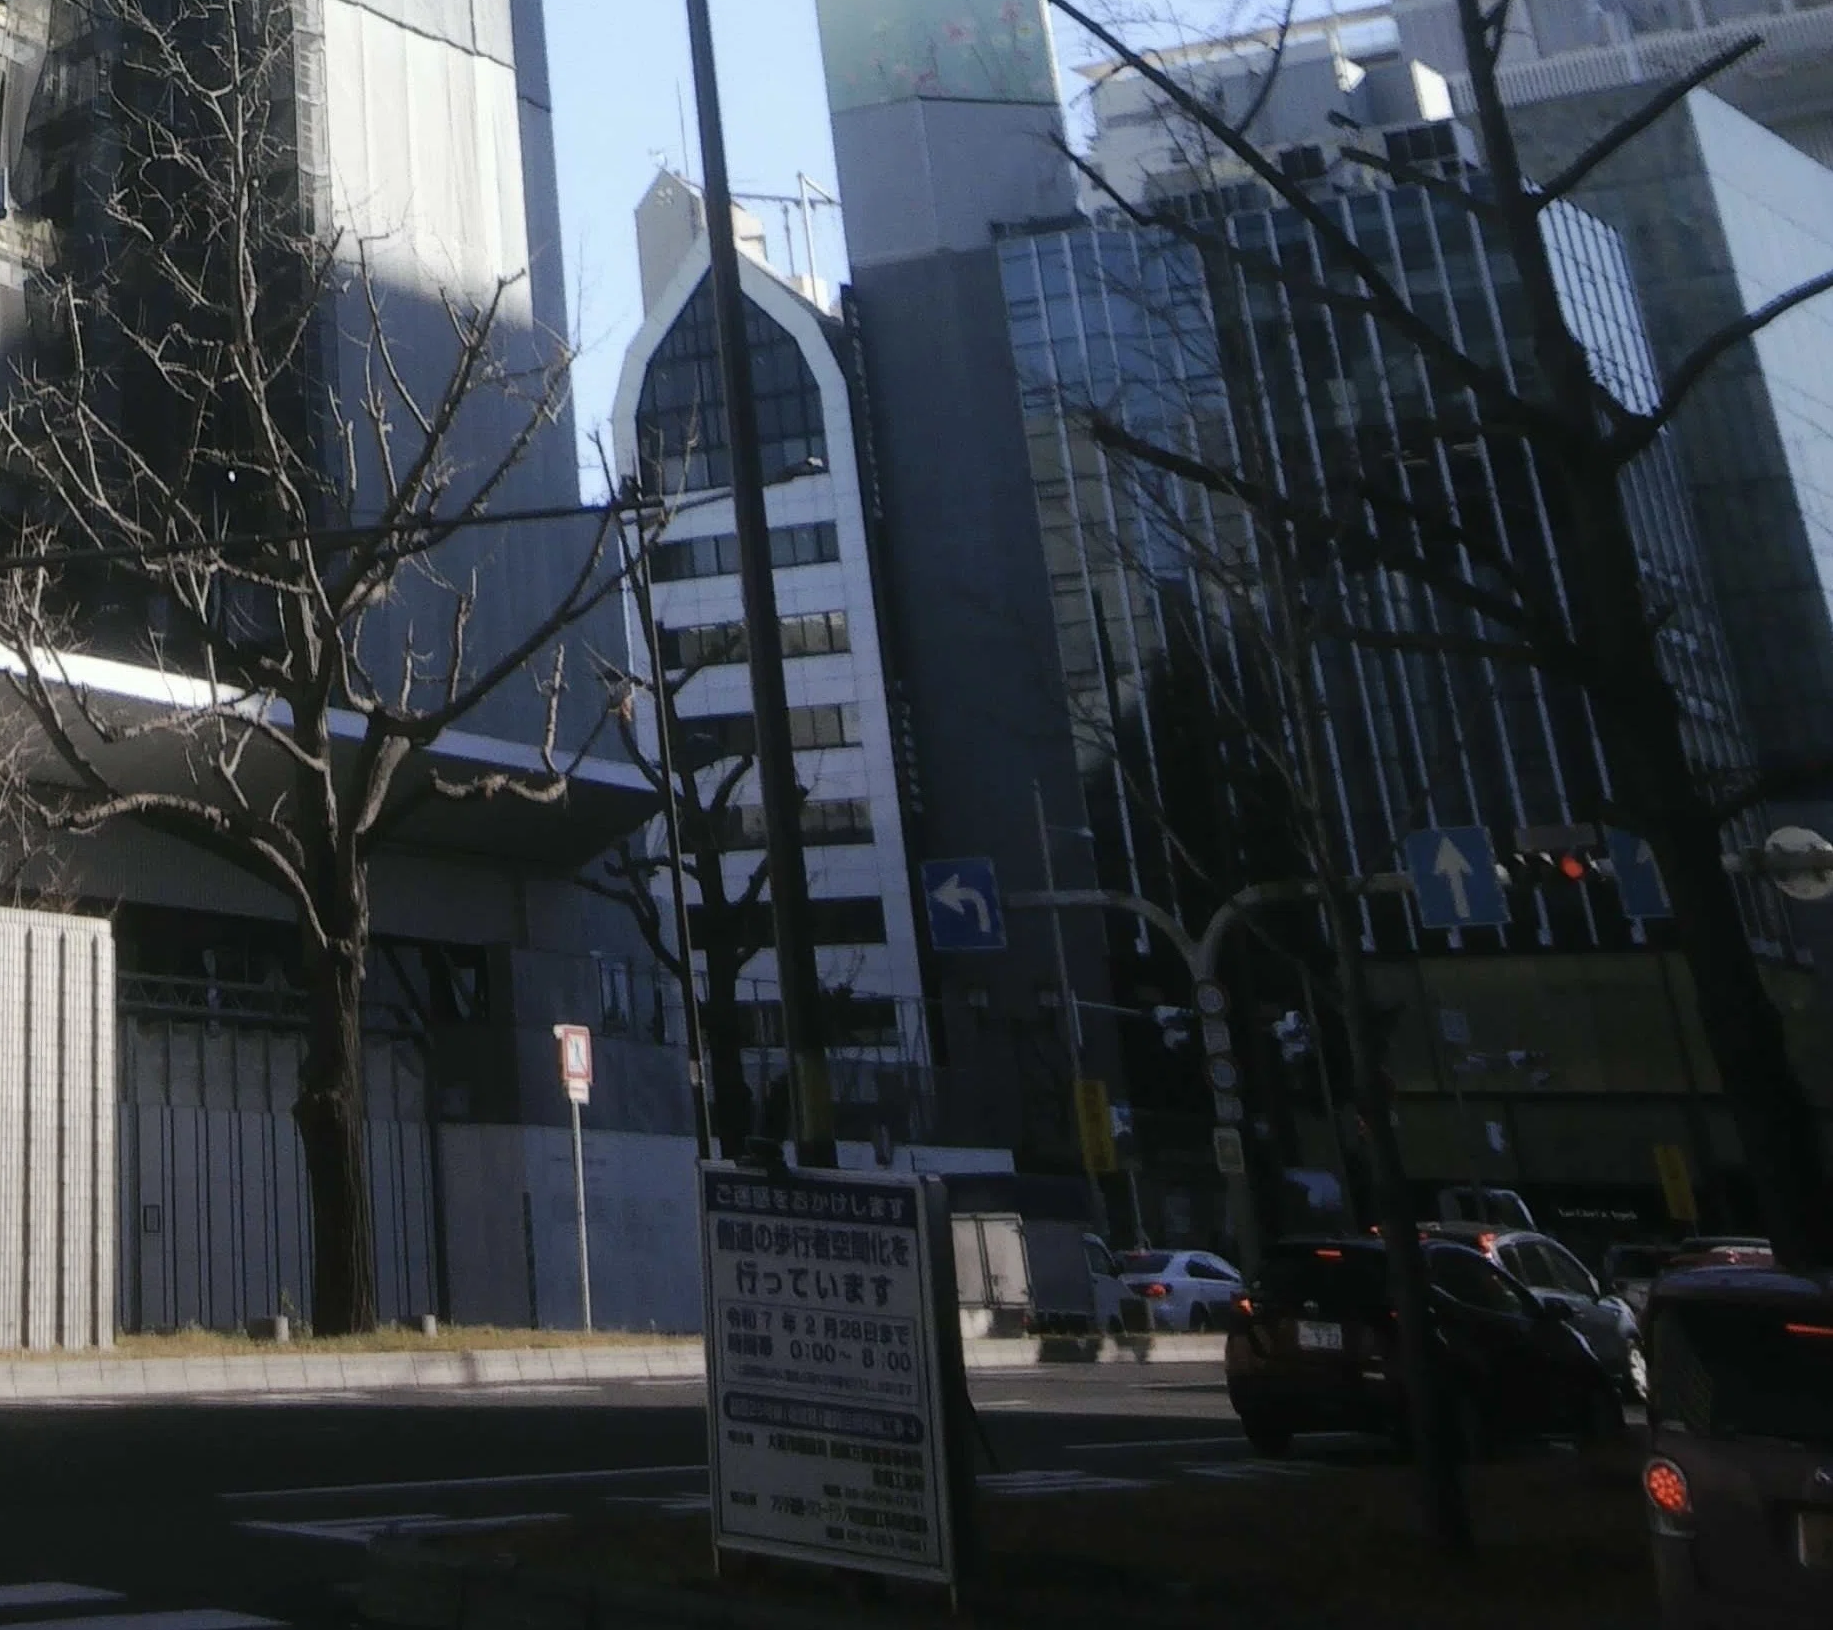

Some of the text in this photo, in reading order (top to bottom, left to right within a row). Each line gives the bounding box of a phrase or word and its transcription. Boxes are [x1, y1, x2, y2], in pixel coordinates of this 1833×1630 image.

[716, 1183, 906, 1221] ご迷惑をおかけします
[736, 1260, 894, 1307] 行っています
